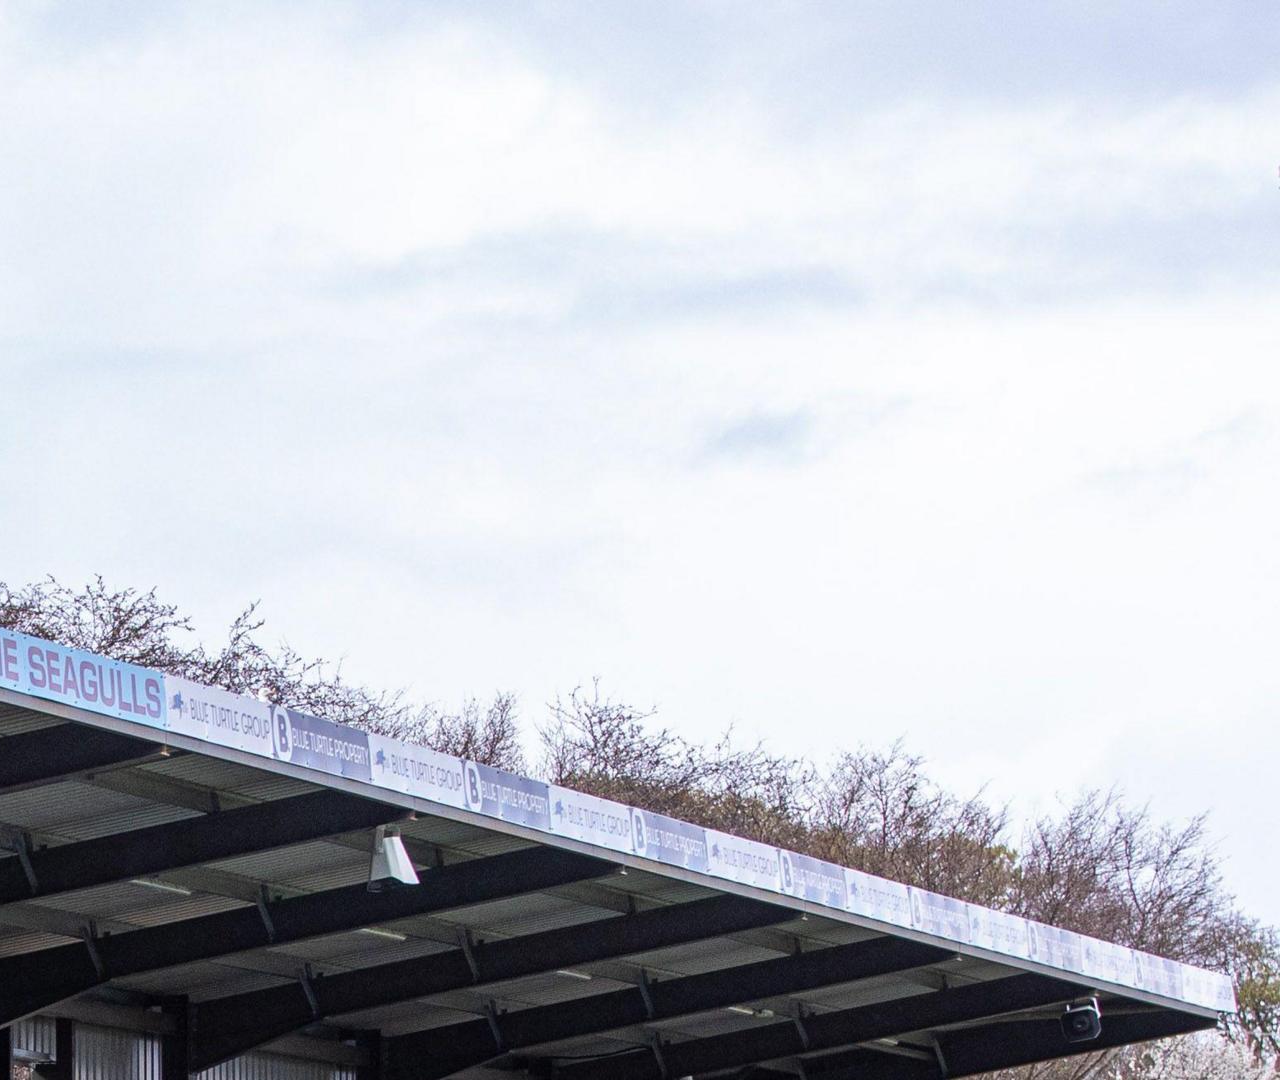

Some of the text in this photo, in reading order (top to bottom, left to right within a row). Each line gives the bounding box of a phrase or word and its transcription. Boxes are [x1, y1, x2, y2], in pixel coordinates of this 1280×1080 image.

[27, 645, 163, 720] SEAGULLS
[189, 698, 271, 741] BLUE TURTLE GROUP
[291, 726, 311, 749] BLUE
[334, 736, 370, 767] PROPERTY
[391, 753, 410, 779] BLUE
[438, 764, 462, 793] GROUP
